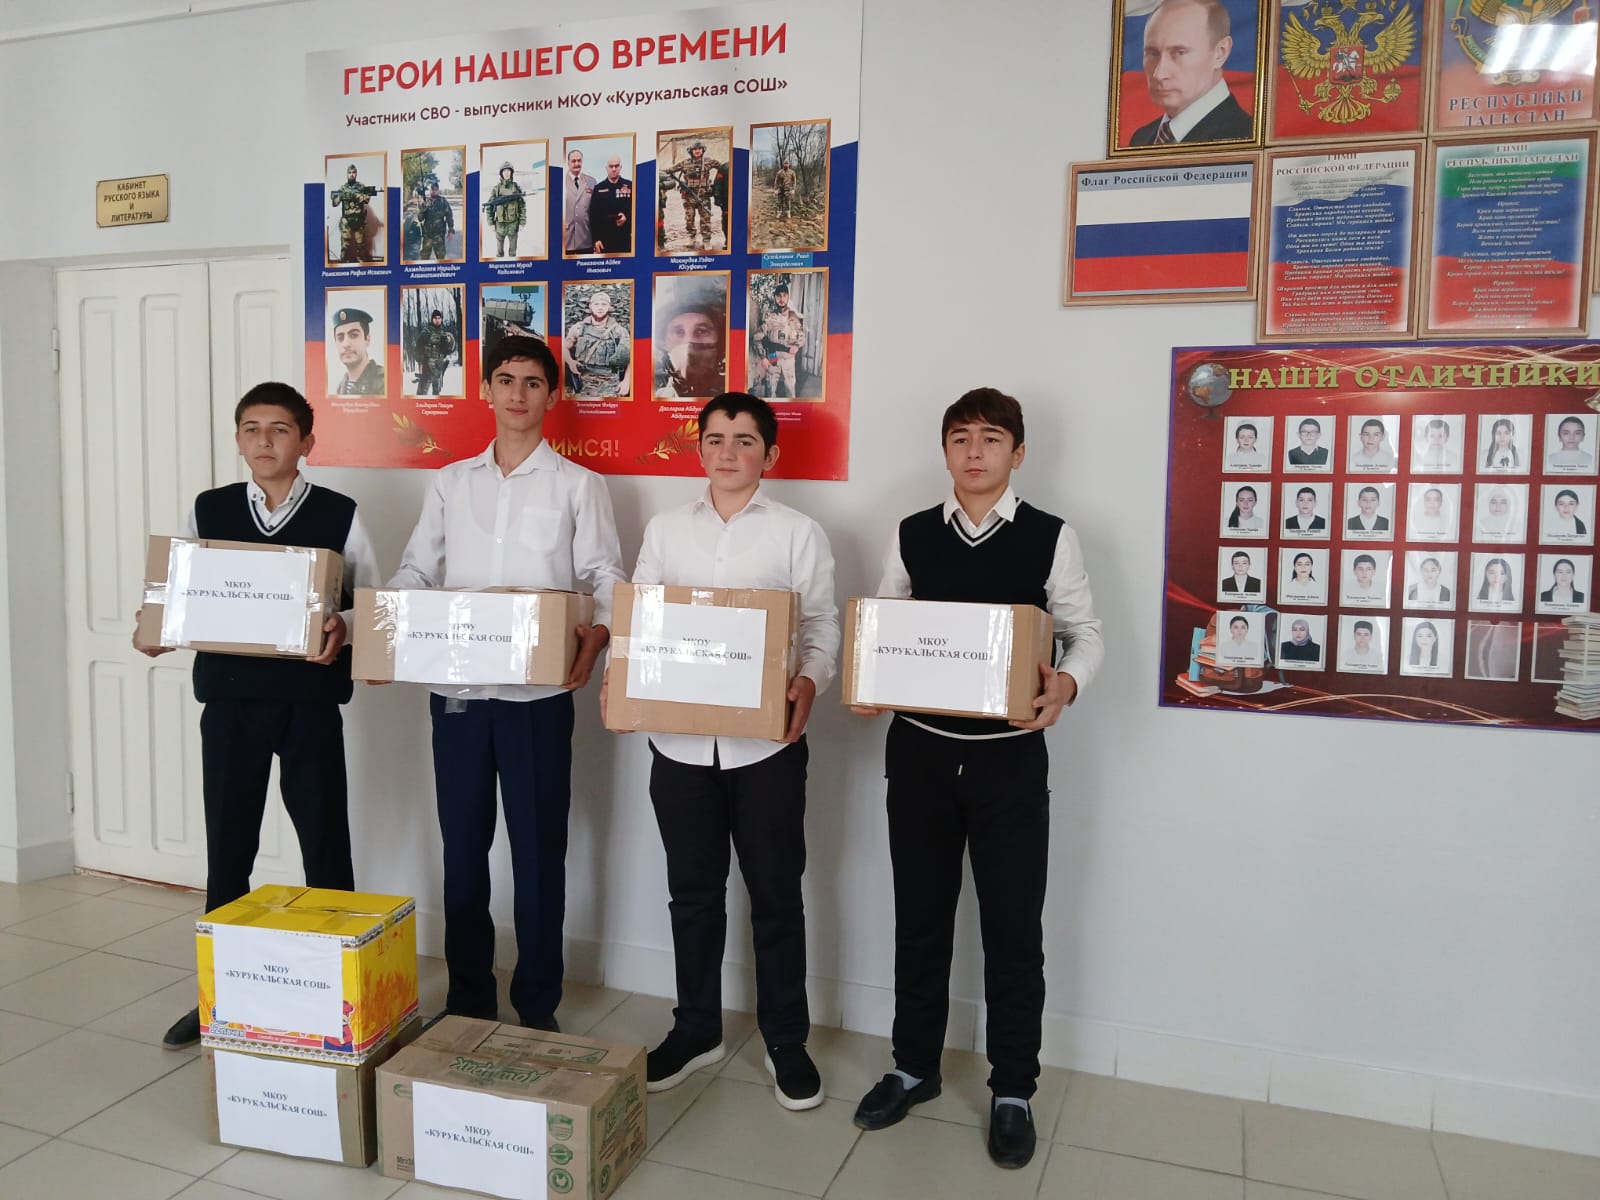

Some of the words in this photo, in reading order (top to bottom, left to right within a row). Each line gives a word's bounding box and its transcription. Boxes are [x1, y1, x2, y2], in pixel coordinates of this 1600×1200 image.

[344, 58, 442, 95] ГЕРОИ
[455, 42, 600, 84] НАШЕГО
[613, 23, 787, 69] ВРЕМЕНИ
[346, 110, 416, 127] Участники
[420, 106, 451, 121] СВО
[464, 98, 552, 118] выпускники
[558, 92, 602, 109] МКОУ
[606, 84, 729, 107] «Курукальская
[734, 77, 788, 95] СОШ»
[1450, 89, 1582, 111] РЕСПУБЛИКИ
[1276, 164, 1345, 176] РОССИЙСКОЙ
[1081, 177, 1110, 187] Флаг
[1114, 173, 1180, 185] Российской
[1183, 169, 1248, 181] Федерации
[117, 181, 146, 191] КАБИНЕТ
[104, 192, 136, 202] РУССКОГО
[137, 190, 160, 199] ЯЗЫКА
[111, 212, 152, 222] ЛИТЕРАТУРЫ
[1227, 367, 1340, 390] НАШИ
[1354, 363, 1600, 388] ОТЛИЧНИКИ
[551, 438, 620, 458] ИМСЯ!
[224, 580, 254, 589] МКОУ
[181, 590, 264, 600] «КУРУКАЛЬСКАЯ
[266, 592, 295, 601] СОШ»
[489, 634, 513, 643] СОШ
[918, 636, 949, 647] МКОУ
[723, 651, 752, 662] СОШ»
[873, 646, 961, 660] «КУРУКАЛЬСКАЯ
[263, 964, 290, 974] МКОУ
[225, 969, 302, 988] «КУРУКАЛЬСКАЯ
[303, 979, 331, 991] СОШ»
[262, 1091, 288, 1101] МКОУ
[227, 1095, 300, 1114] «КУРУКАЛЬСКАЯ
[301, 1107, 328, 1118] СОШ»
[464, 1125, 493, 1137] МКОУ
[424, 1128, 504, 1150] «КУРУКАЛЬСКАЯ
[506, 1143, 535, 1155] СОШ»
